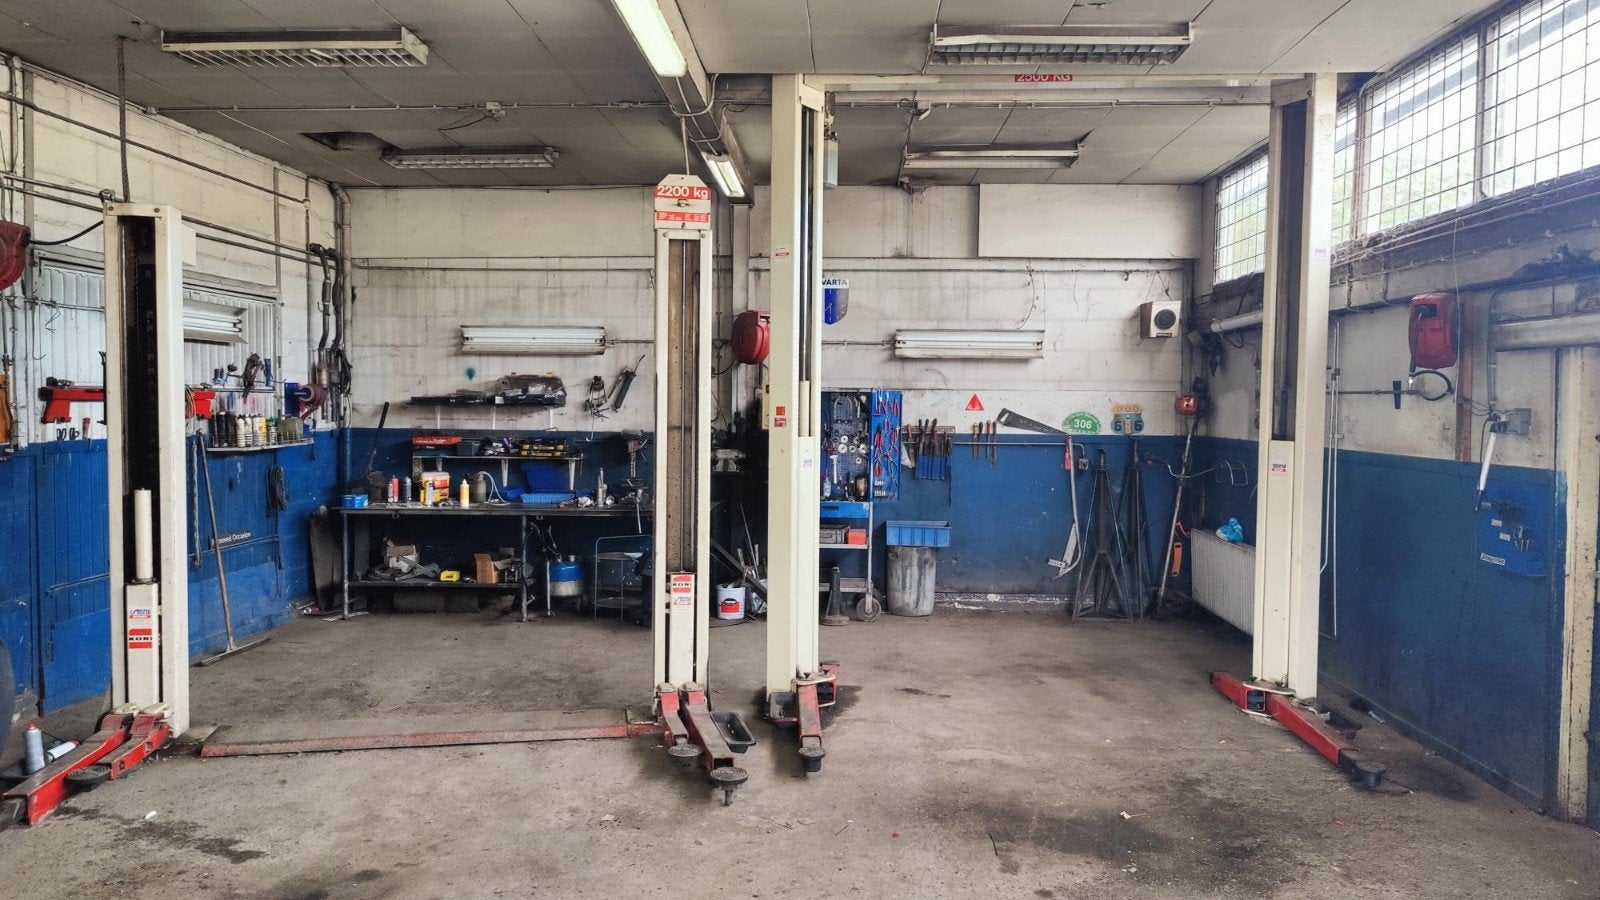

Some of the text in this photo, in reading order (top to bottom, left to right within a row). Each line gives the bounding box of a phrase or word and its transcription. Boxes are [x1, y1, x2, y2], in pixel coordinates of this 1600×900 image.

[656, 185, 709, 200] 2200 kg
[1074, 418, 1093, 429] 306
